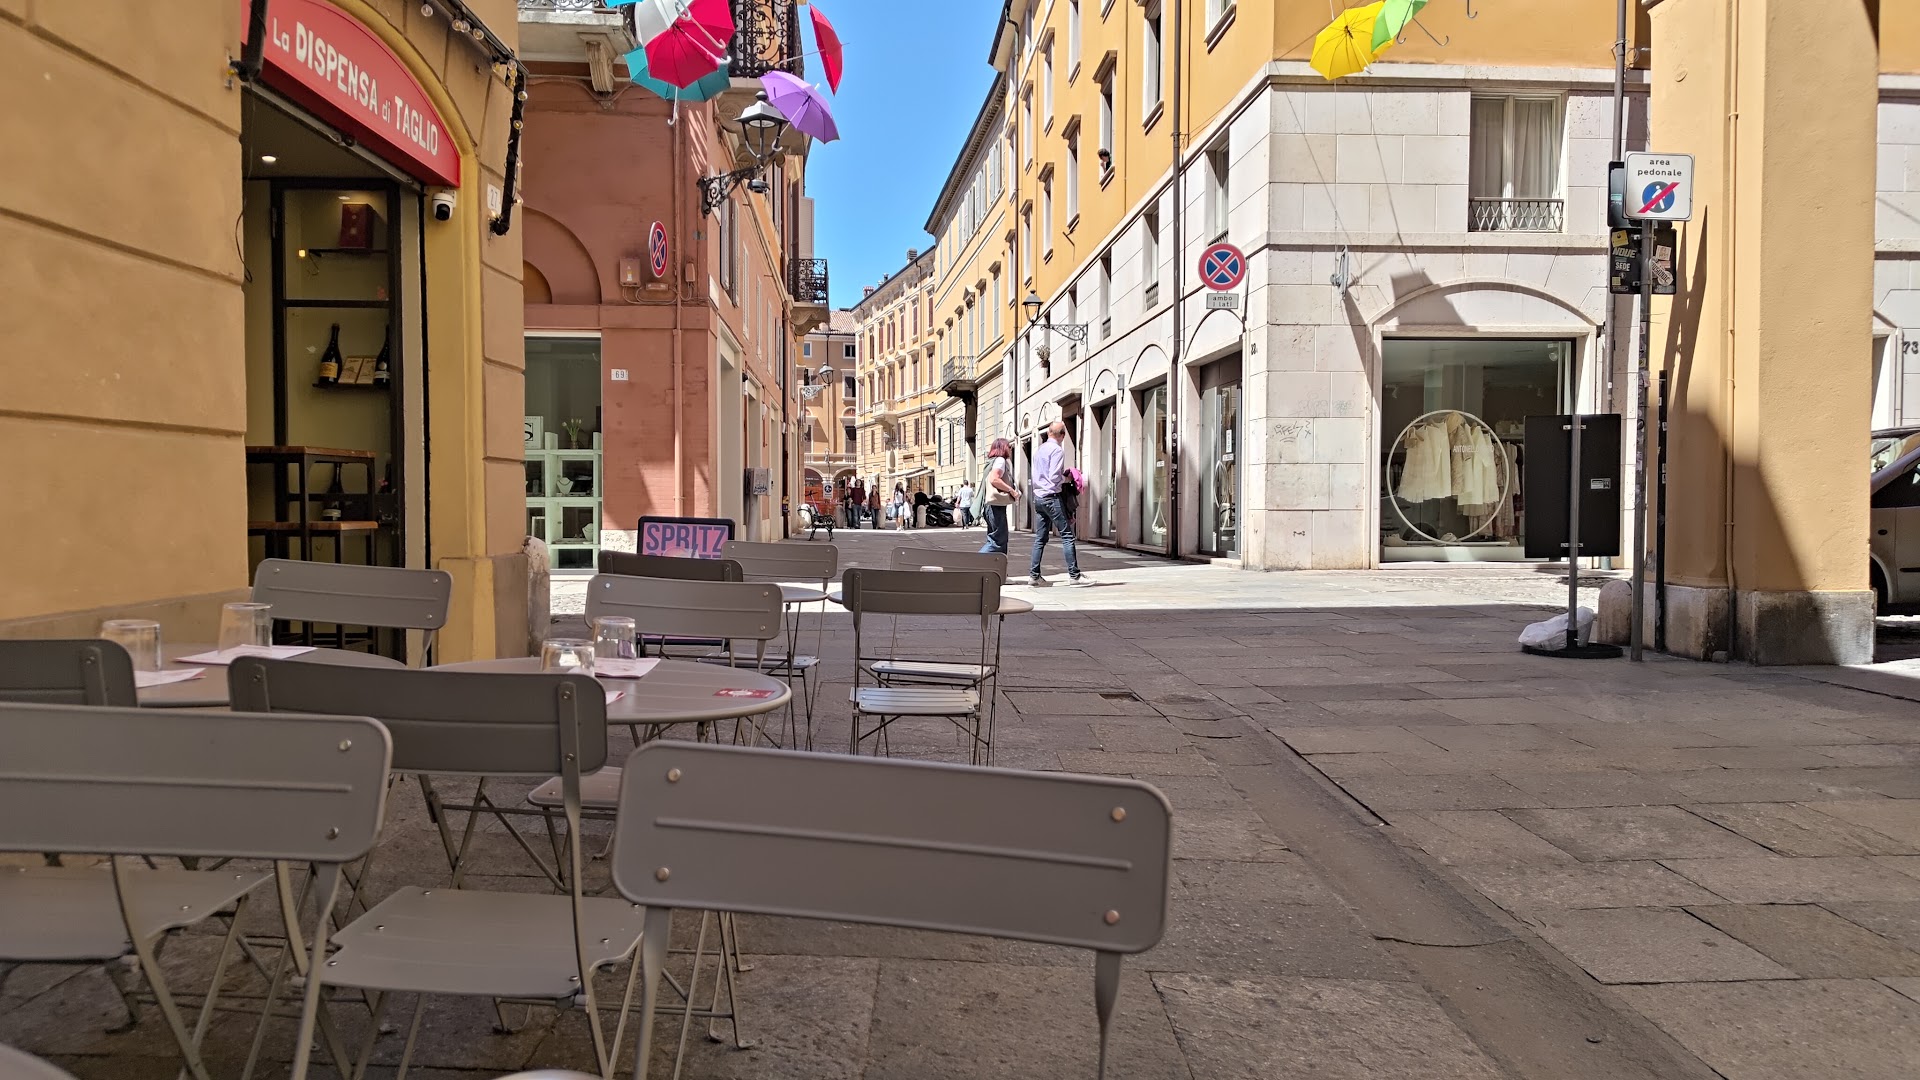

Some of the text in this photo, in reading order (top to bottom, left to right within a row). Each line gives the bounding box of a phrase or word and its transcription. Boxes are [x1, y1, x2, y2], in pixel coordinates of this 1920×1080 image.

[273, 17, 439, 156] La DISPENSA di TAGLIO
[490, 188, 498, 208] 27
[1903, 340, 1919, 355] 73
[615, 370, 625, 379] 69
[646, 524, 727, 553] SPRITZ
